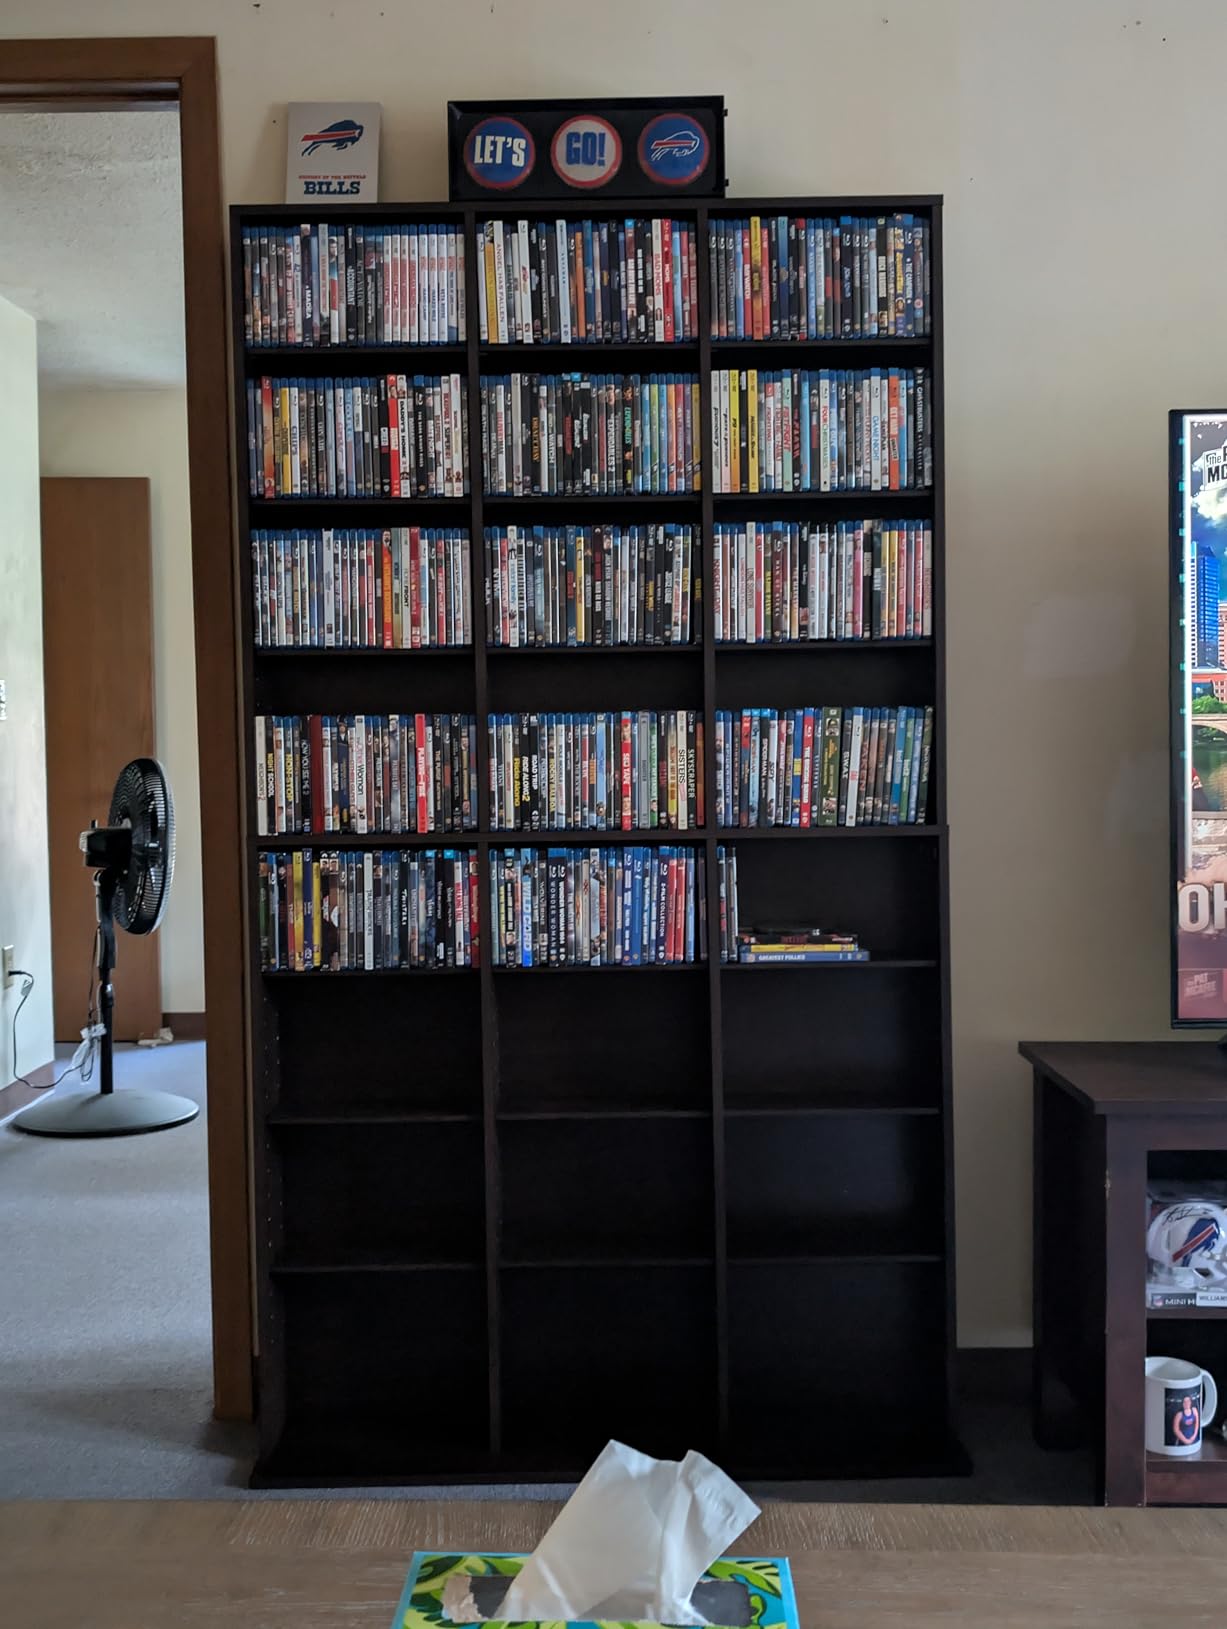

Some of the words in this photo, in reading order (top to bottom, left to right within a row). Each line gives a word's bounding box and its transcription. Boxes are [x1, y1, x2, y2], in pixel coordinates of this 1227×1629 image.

[473, 133, 527, 169] LET'S
[565, 131, 607, 168] GO!
[303, 181, 361, 195] BILLS
[303, 780, 309, 789] ME
[523, 881, 531, 913] WILD
[523, 915, 531, 951] CARD
